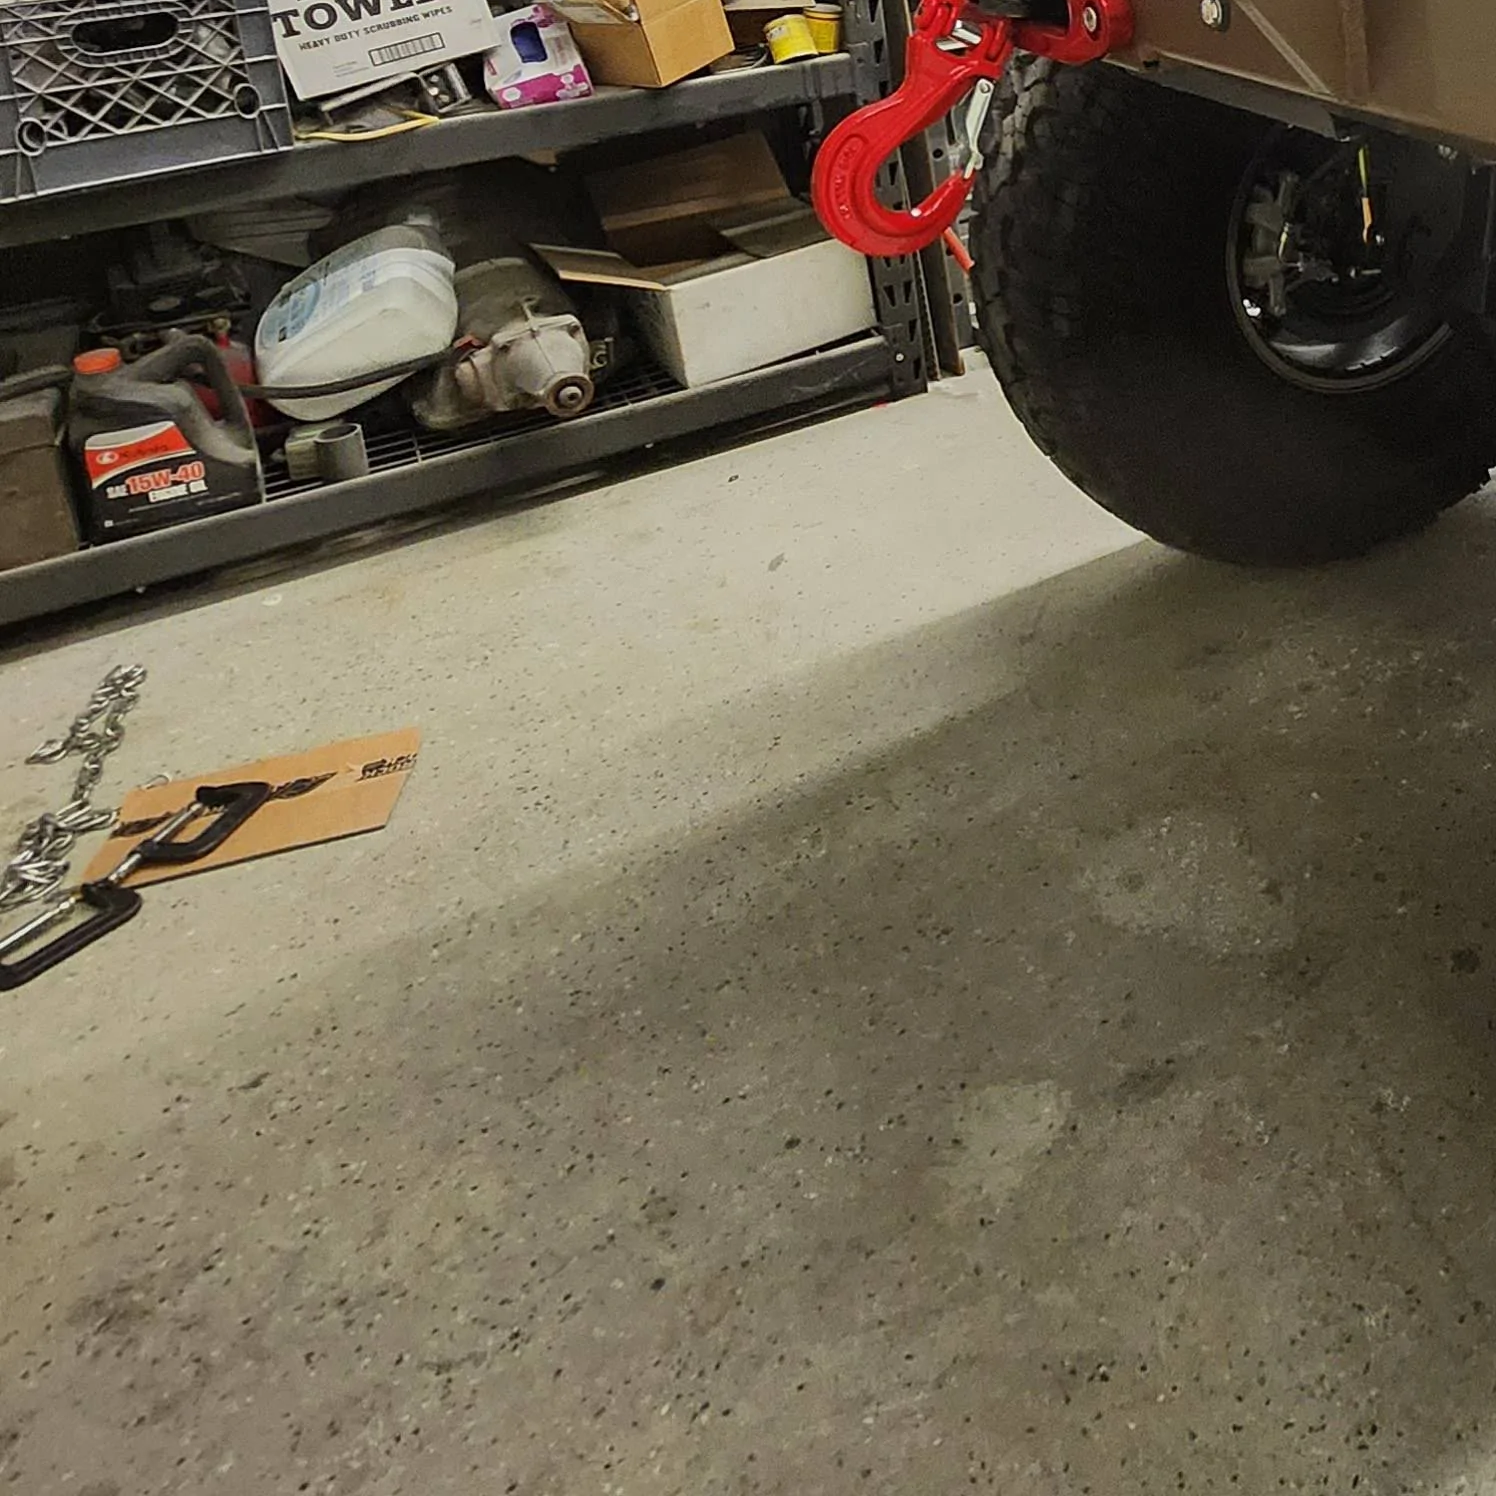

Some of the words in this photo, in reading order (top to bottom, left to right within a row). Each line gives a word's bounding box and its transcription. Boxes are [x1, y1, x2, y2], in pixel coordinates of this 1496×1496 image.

[299, 36, 331, 51] HEAVY
[334, 30, 360, 42] DUTY
[363, 14, 420, 35] SCRUBBING
[422, 5, 453, 20] WIPES
[126, 461, 205, 494] 15W-40
